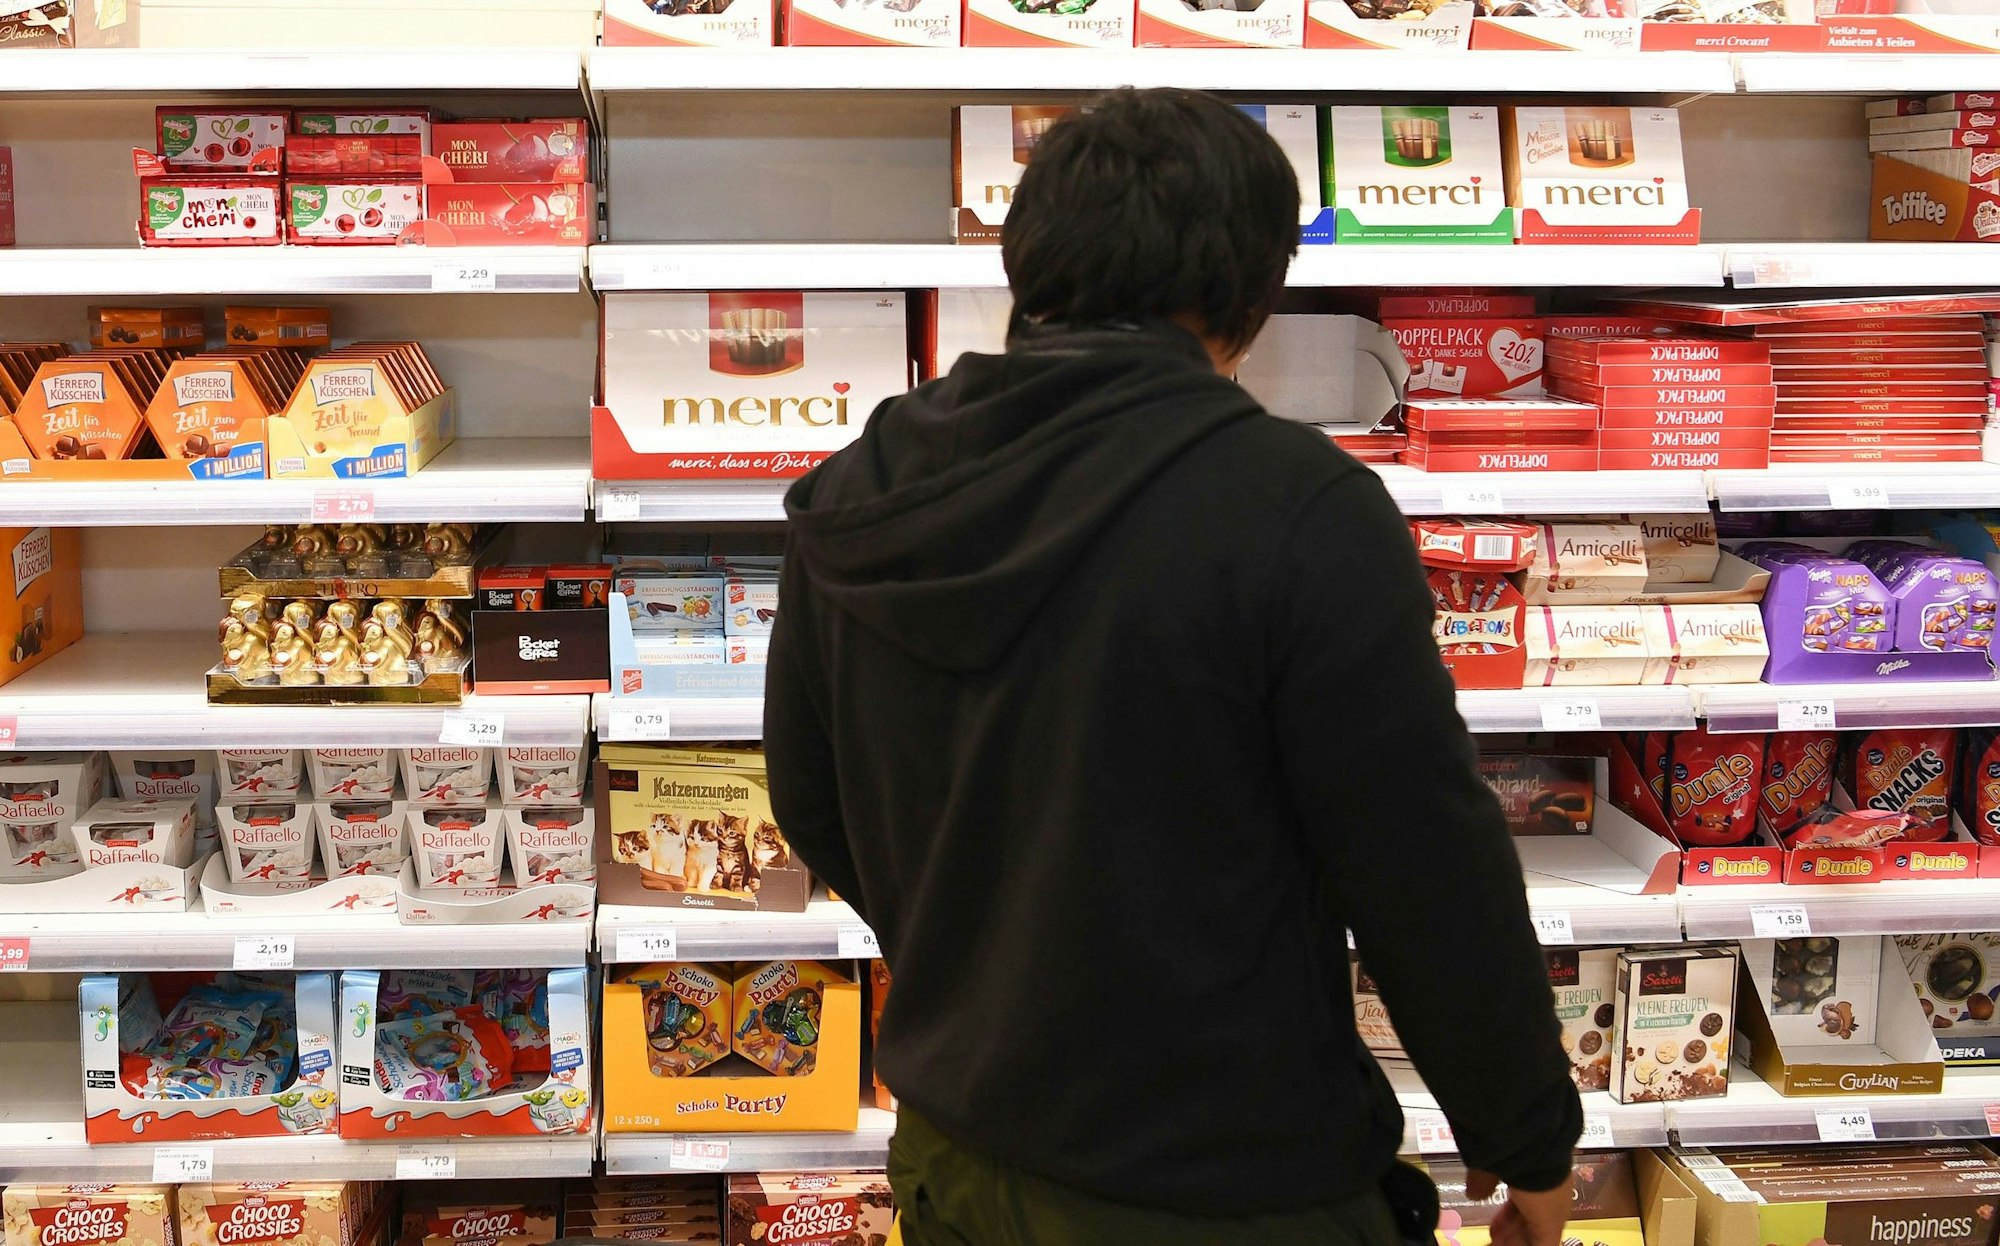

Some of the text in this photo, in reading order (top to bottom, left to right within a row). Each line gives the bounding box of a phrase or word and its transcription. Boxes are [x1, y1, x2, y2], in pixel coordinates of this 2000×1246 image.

[704, 18, 759, 31] merci
[895, 17, 951, 29] merci
[1068, 18, 1122, 30] merci
[1237, 17, 1291, 29] merci
[1829, 26, 1857, 35] Vielfalt
[0, 24, 46, 42] Classic
[1406, 27, 1460, 38] merci
[1584, 29, 1634, 40] merci
[1695, 36, 1770, 47] merci Crocant
[1828, 37, 1915, 47] Anbieten & Teilen
[451, 140, 477, 150] MON
[1359, 179, 1482, 206] merci
[1545, 180, 1664, 206] merci
[447, 200, 474, 211] MON
[1882, 191, 1947, 225] Toffifee
[459, 269, 488, 280] 2,29
[1428, 299, 1489, 313] DOPPELPACK
[1863, 304, 1890, 313] merci
[1393, 328, 1483, 346] DOPPELPACK
[1435, 349, 1457, 358] DANKE
[1460, 349, 1483, 358] SAGEN
[1499, 341, 1536, 364] -20%
[1651, 346, 1719, 360] DOPPELPACK
[184, 376, 226, 388] FERRERO
[323, 375, 366, 387] FERRERO
[1653, 367, 1721, 382] DOPPELPACK
[54, 378, 97, 389] FERRERO
[1860, 387, 1888, 395] merci
[50, 388, 100, 401] KÜSSCHEN
[181, 387, 229, 400] KÜSSCHEN
[319, 385, 369, 398] KÜSSCHEN
[1657, 389, 1725, 403] DOPPELPACK
[662, 390, 849, 427] merci
[1861, 403, 1889, 411] merci
[43, 408, 100, 435] Zeit für
[172, 406, 236, 434] Zeit zum
[312, 405, 369, 431] Zeit für
[1655, 410, 1723, 425] DOPPELPACK
[1856, 419, 1884, 427] merci
[80, 427, 123, 441] Küsschen
[1651, 431, 1720, 446] DOPPELPACK
[1853, 435, 1881, 443] merci
[668, 456, 717, 470] merci,
[719, 454, 752, 469] dass
[753, 457, 768, 468] es
[770, 453, 810, 473] Dich
[1479, 454, 1548, 469] DOPPELPACK
[1651, 452, 1719, 467] DOPPELPACK
[1854, 451, 1881, 460] merci
[204, 453, 261, 476] 1 MILLION
[346, 453, 403, 476] 1 MILLION
[613, 493, 637, 504] 5,79
[1853, 487, 1880, 498] 9,99
[338, 501, 368, 512] 2,79
[1640, 520, 1710, 539] Amicelli
[21, 535, 48, 561] FERRERO
[1559, 538, 1637, 557] Amicelli
[18, 552, 50, 582] KÜSSCHEN
[557, 580, 582, 590] Pocket
[1836, 574, 1870, 588] NAPS
[1955, 573, 1987, 585] NAPS
[489, 590, 514, 600] Pocket
[489, 598, 513, 606] Coffee
[1559, 620, 1636, 638] Amicelli
[1680, 619, 1756, 637] Amicelli
[519, 635, 560, 650] Pocket
[519, 648, 559, 660] Coffee
[1876, 658, 1912, 675] Milka
[1566, 706, 1592, 716] 2,79
[1802, 705, 1828, 717] 2,79
[635, 714, 663, 726] 0,79
[469, 723, 497, 735] 3,29
[410, 748, 479, 763] Raffaello
[508, 747, 576, 762] Raffaello
[696, 753, 736, 765] Katzenzungen
[1866, 745, 1912, 790] Dumle
[1764, 738, 1836, 813] Dumle
[1869, 749, 1944, 812] SNACKS
[136, 781, 201, 796] Raffaello
[653, 776, 749, 802] Katzenzungen
[1671, 754, 1752, 817] Dumle
[1724, 784, 1750, 804] original
[0, 802, 65, 817] Raffaello
[232, 828, 301, 845] Raffaello
[330, 824, 398, 840] Raffaello
[520, 831, 588, 847] Raffaello
[422, 832, 491, 849] Raffaello
[89, 849, 160, 866] Raffaello
[1910, 852, 1968, 870] Dumle
[1713, 857, 1770, 876] Dumle
[1816, 857, 1873, 876] Dumle
[682, 895, 715, 907] Sarotti
[405, 912, 436, 921] Raffaello
[1777, 914, 1803, 926] 1,59
[1539, 919, 1565, 930] 1,19
[643, 938, 671, 950] 1,19
[678, 966, 715, 989] Schoko
[752, 962, 785, 989] Schoko
[1643, 973, 1684, 988] Sarotti
[664, 969, 719, 1006] Party
[748, 963, 799, 1006] Party
[1564, 989, 1602, 1005] FREUDEN
[1637, 997, 1709, 1015] KLEINE FREUDEN
[676, 1092, 788, 1116] Schoko Party
[614, 1116, 625, 1126] 12
[634, 1115, 652, 1126] 250
[654, 1118, 660, 1127] g
[1841, 1116, 1866, 1128] 4,49
[180, 1160, 207, 1171] 1,79
[422, 1155, 449, 1166] 1,79
[55, 1207, 115, 1228] CHOCO
[231, 1204, 291, 1225] CHOCO
[782, 1201, 845, 1225] CHOCO
[42, 1221, 124, 1246] CROSSIES
[218, 1218, 301, 1243] CROSSIES
[452, 1214, 511, 1238] CHOCO
[767, 1215, 854, 1244] CROSSIES
[1870, 1212, 1973, 1245] happiness
